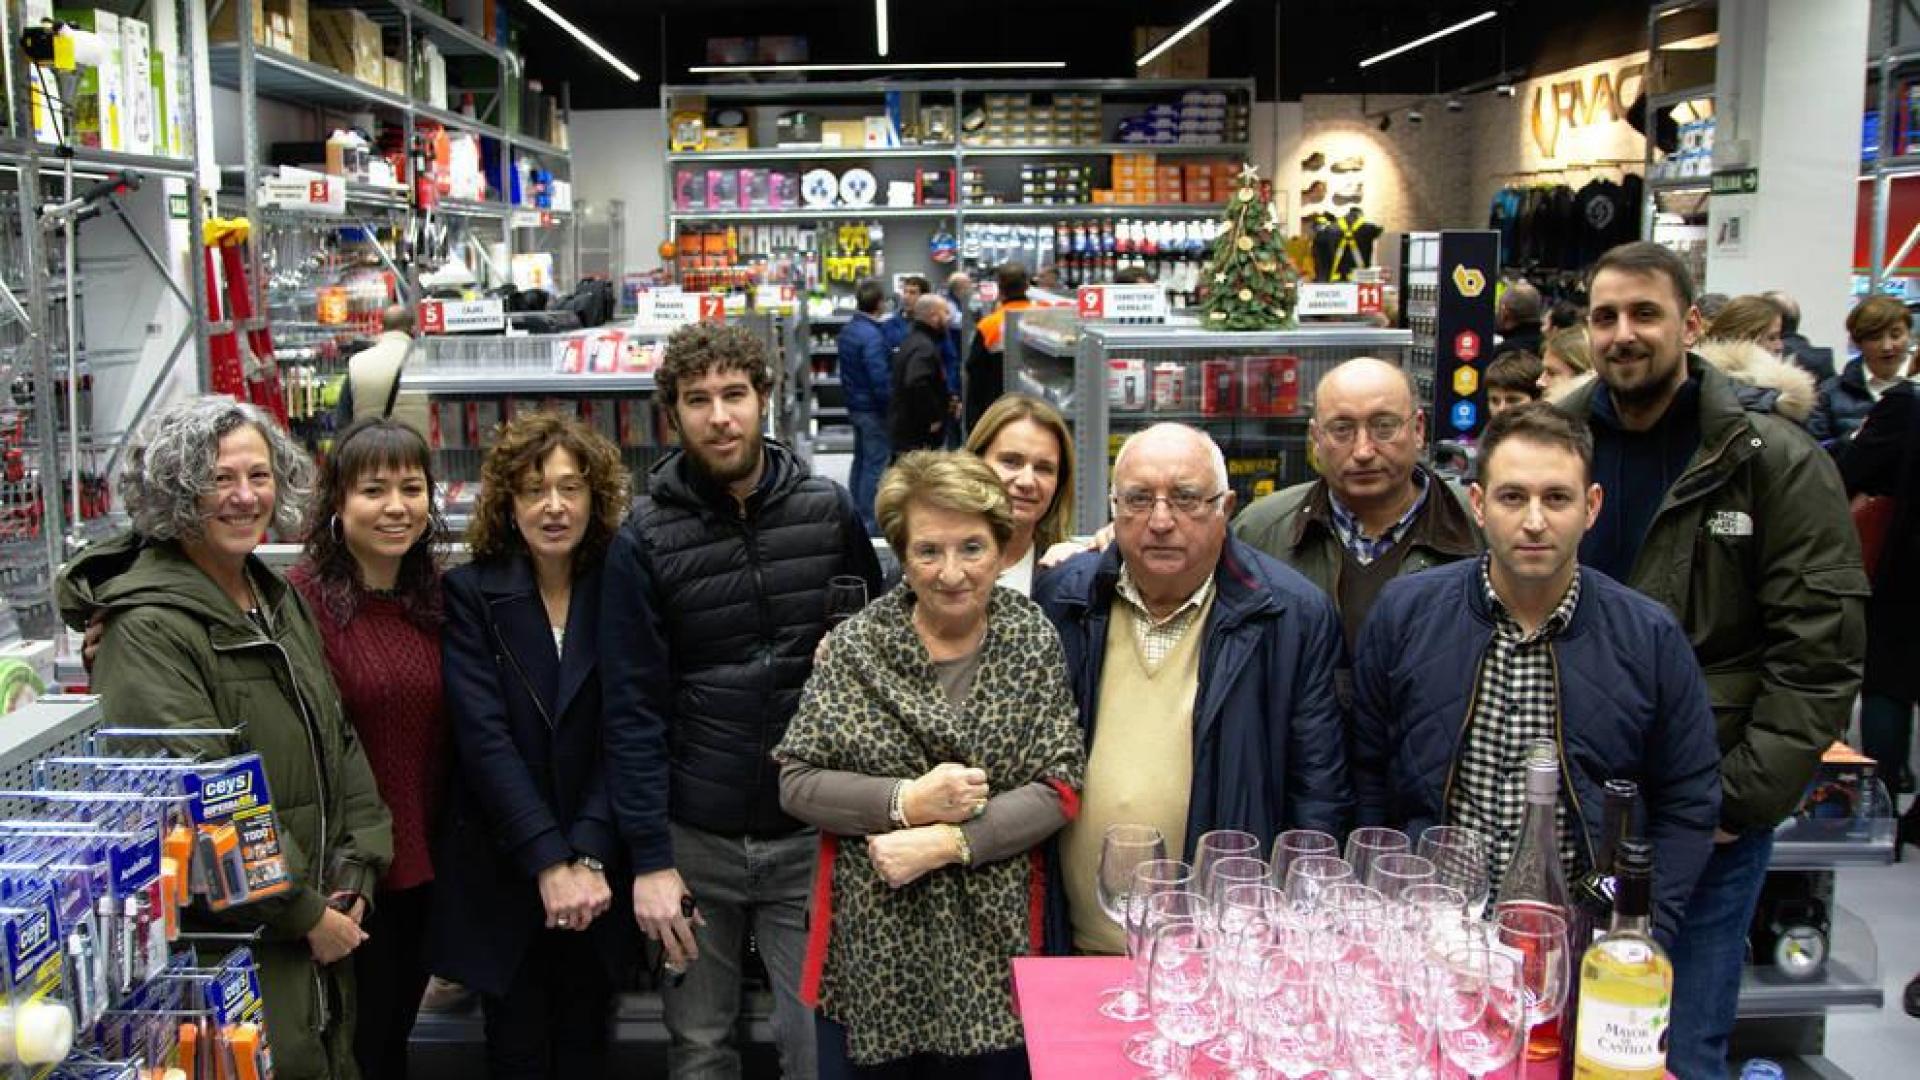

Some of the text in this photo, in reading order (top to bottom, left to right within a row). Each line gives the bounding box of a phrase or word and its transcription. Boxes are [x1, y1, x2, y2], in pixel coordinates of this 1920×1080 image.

[314, 183, 324, 197] 3
[1084, 291, 1099, 309] 9
[1360, 288, 1380, 305] 11
[426, 305, 438, 323] 5
[705, 300, 719, 318] 7
